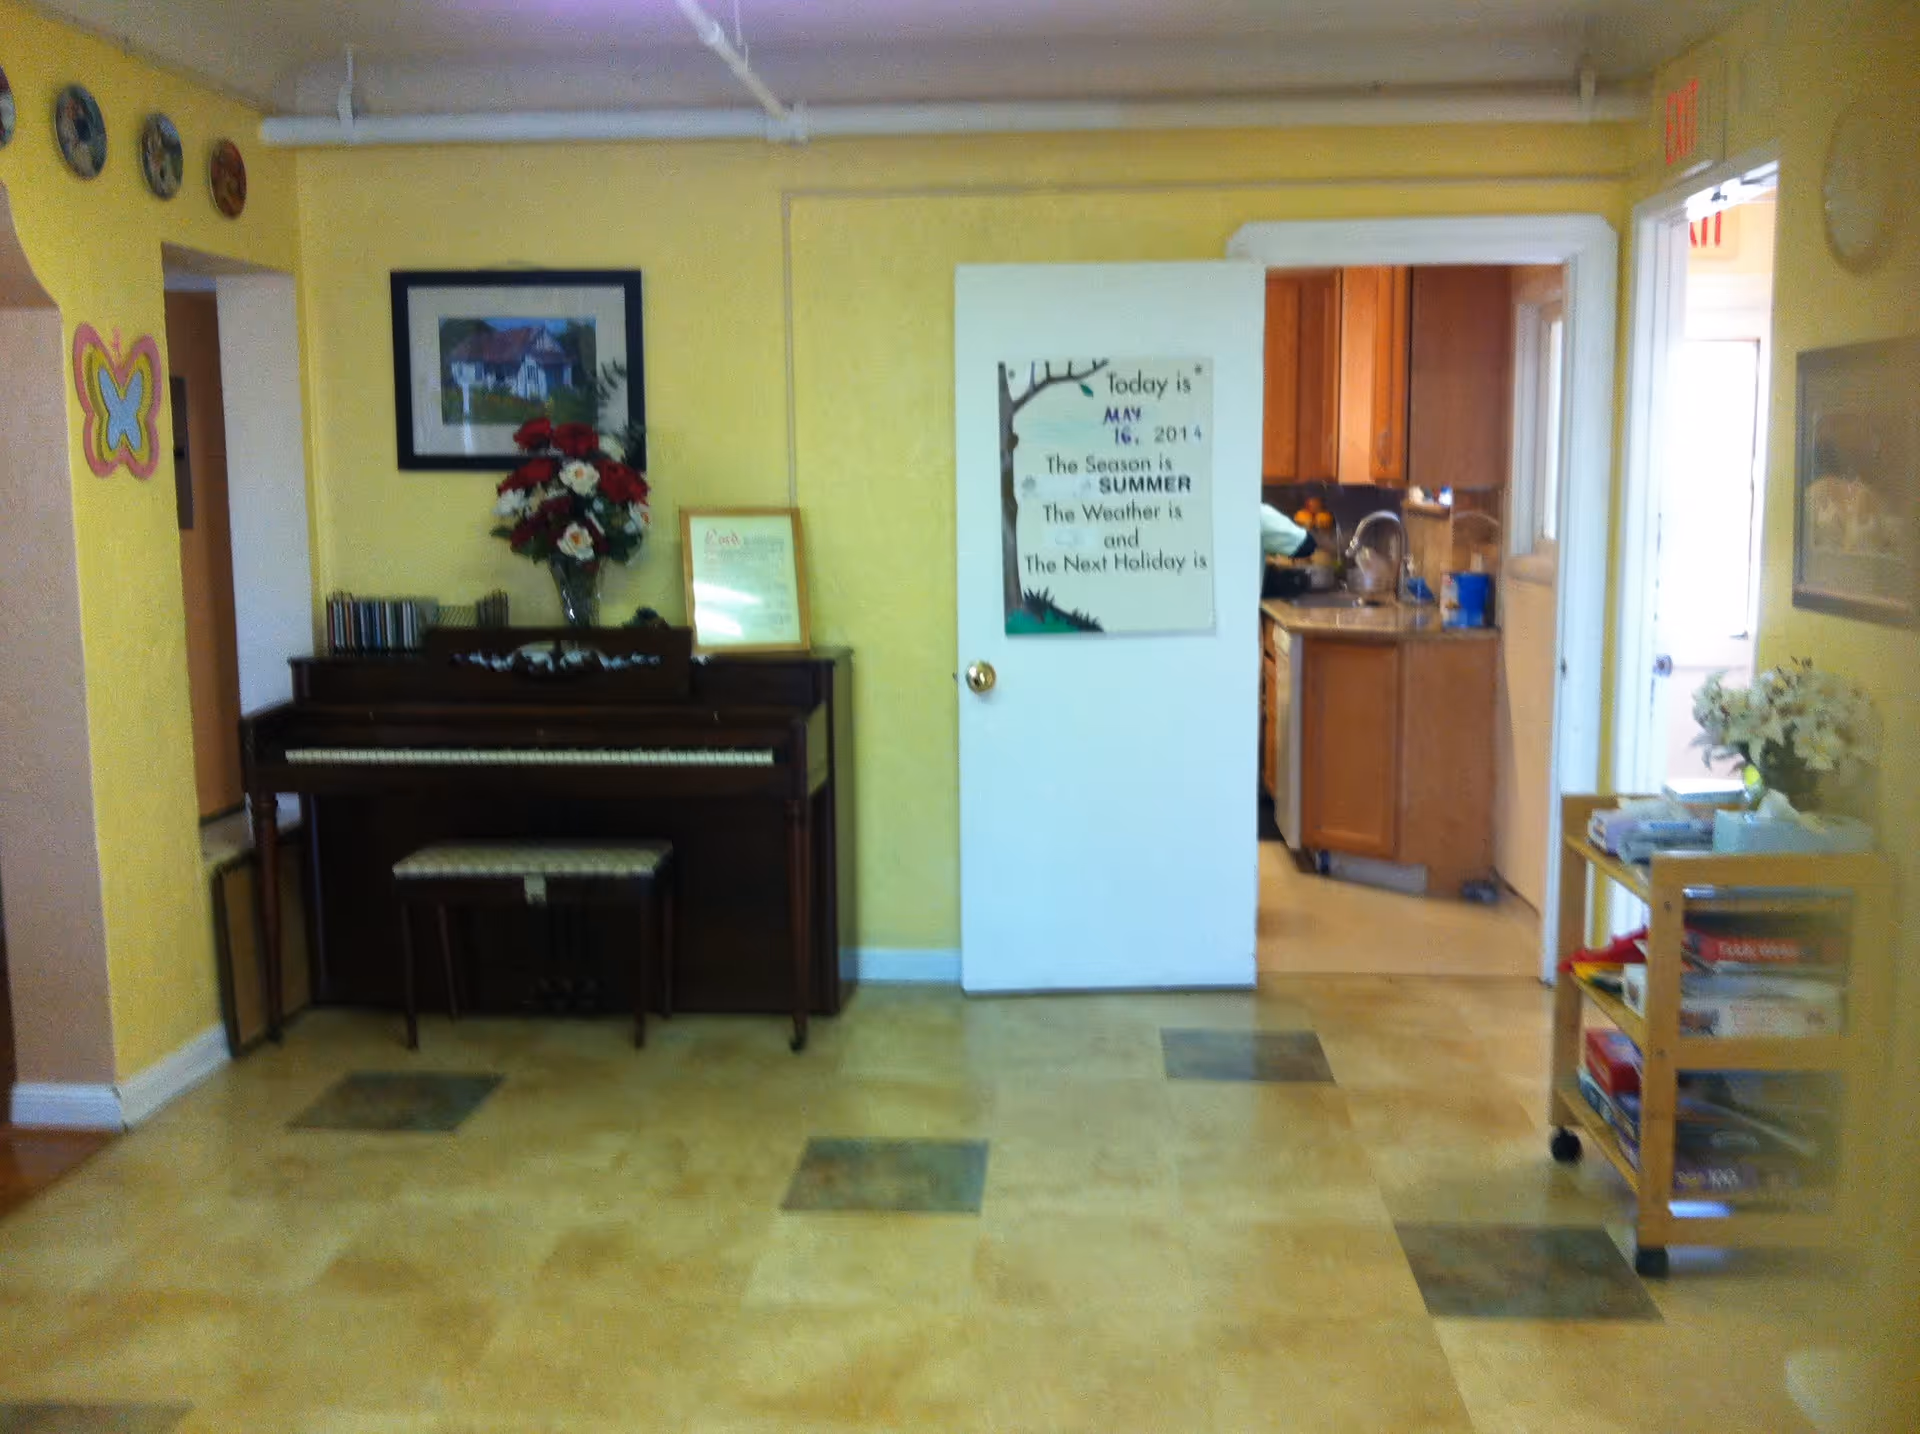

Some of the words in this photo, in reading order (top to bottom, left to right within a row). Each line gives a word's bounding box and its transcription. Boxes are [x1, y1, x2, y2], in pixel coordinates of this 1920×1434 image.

[1106, 369, 1169, 400] Today
[1176, 369, 1192, 394] is
[1103, 406, 1142, 425] MAY
[1046, 453, 1079, 475] The
[1085, 455, 1151, 473] Season
[1158, 452, 1173, 472] is
[1098, 474, 1192, 494] SUMMER
[1042, 502, 1076, 524] The
[1081, 498, 1161, 522] Weather
[1168, 500, 1184, 520] is
[1103, 526, 1140, 549] and
[1024, 553, 1057, 575] The
[1063, 554, 1107, 573] Next
[1114, 549, 1187, 576] Holiday
[1193, 551, 1209, 569] is
